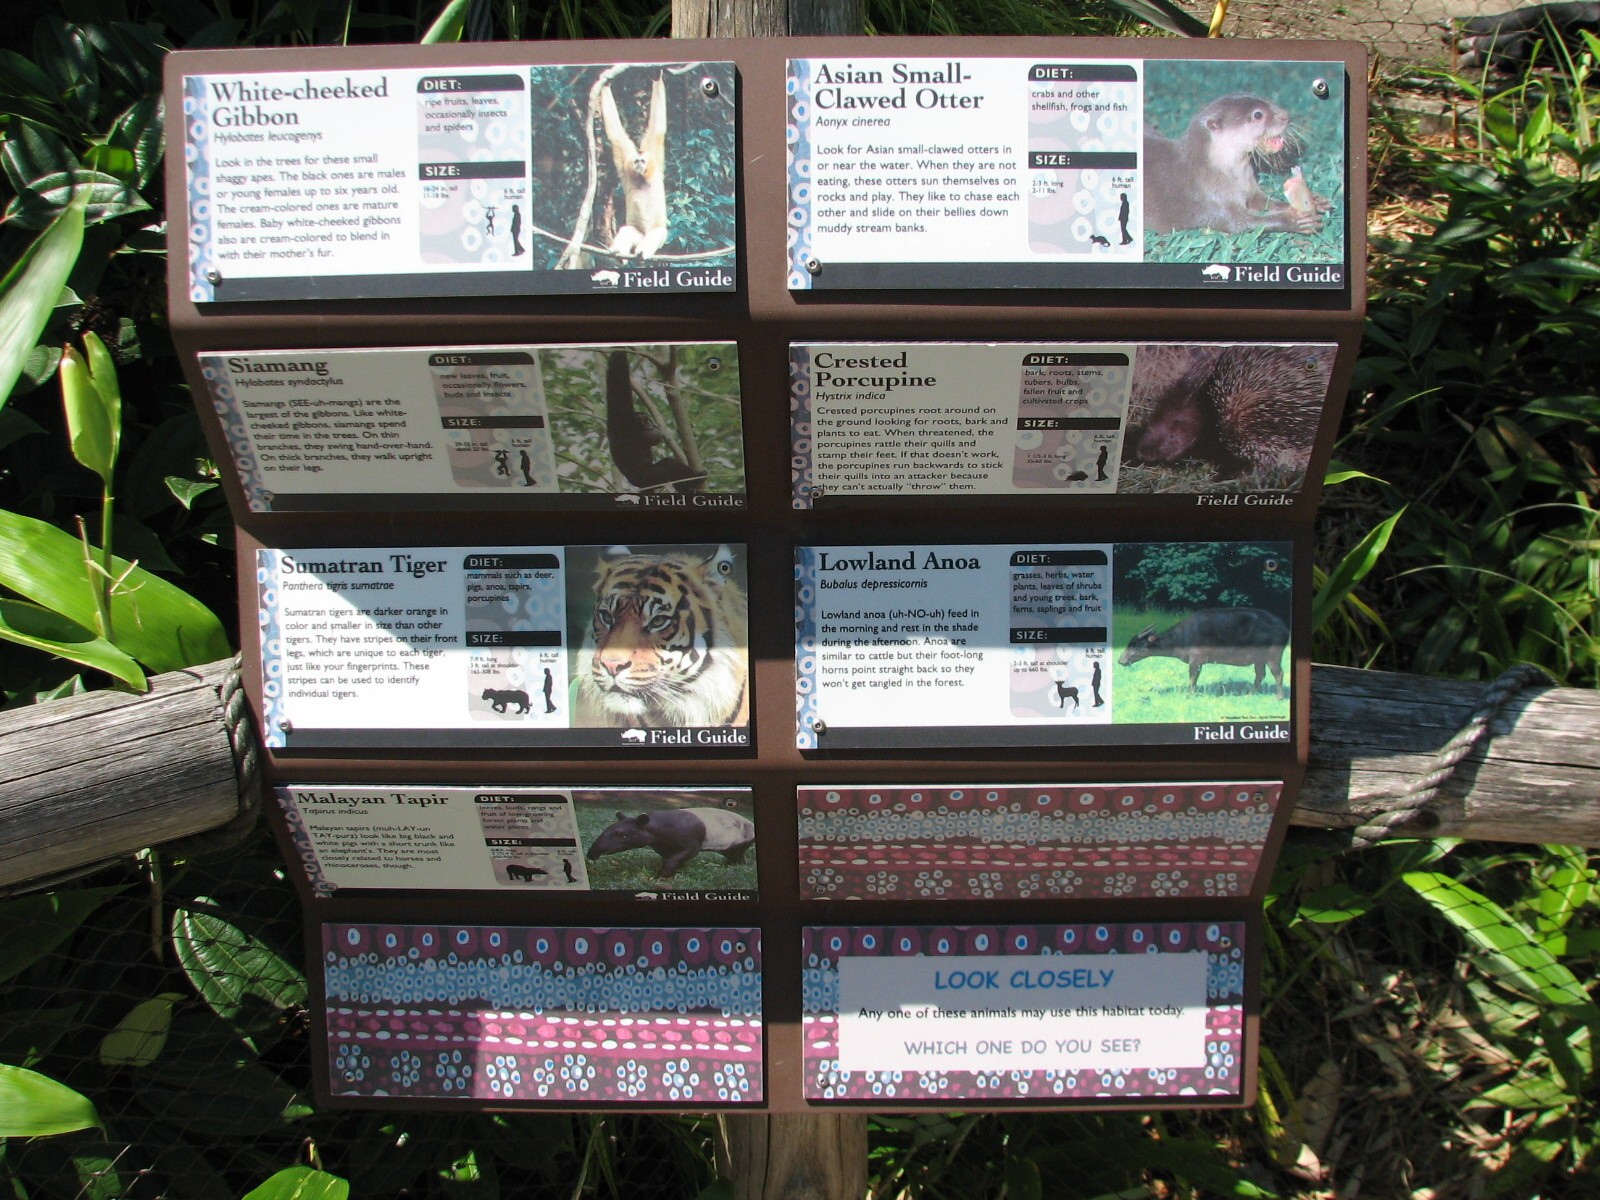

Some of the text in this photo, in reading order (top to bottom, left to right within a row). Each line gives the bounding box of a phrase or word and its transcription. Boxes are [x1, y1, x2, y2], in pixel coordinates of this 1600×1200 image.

[814, 62, 971, 84] Asian Small-
[1035, 68, 1073, 79] DIET:
[210, 77, 388, 101] White-cheeked
[423, 79, 461, 90] DIET:
[815, 87, 984, 109] Clawed Otter
[1031, 89, 1100, 99] crabs and other
[423, 96, 499, 108] ripe fruits, leaves,
[1031, 101, 1128, 113] shellfish, frogs and fish
[211, 106, 299, 127] Gibbon
[424, 109, 508, 121] occasionally insects
[424, 122, 474, 133] and spiders
[815, 116, 891, 129] Aonyx cinerea
[213, 130, 323, 145] Hylobates leucogenys
[816, 144, 1011, 154] Look for Asian small-clawed otters in
[1035, 154, 1070, 164] SIZE:
[424, 165, 460, 176] SIZE:
[1051, 180, 1064, 188] long
[216, 201, 399, 213] The cream-colored ones are mature
[623, 270, 732, 287] Field Guide
[1234, 265, 1340, 282] Field Guide
[228, 357, 329, 375] Siamang
[435, 356, 470, 364] DIET:
[814, 352, 906, 368] Crested
[1030, 356, 1068, 364] DIET:
[1025, 369, 1045, 377] bark,
[235, 378, 284, 387] Hylobates
[815, 370, 936, 391] Porcupine
[815, 391, 885, 401] Hystrix indica
[860, 406, 915, 416] porcupines
[944, 406, 980, 415] around
[644, 493, 743, 506] Field Guide
[1195, 494, 1293, 505] Field Guide
[281, 554, 447, 575] Sumatran Tiger
[469, 557, 502, 568] DIET:
[818, 551, 981, 571] Lowland Anoa
[1016, 554, 1050, 564] DIET:
[466, 572, 502, 580] mammals
[504, 571, 522, 579] such
[534, 571, 555, 579] deer,
[1012, 570, 1094, 581] grasses, herbs, water
[282, 580, 323, 590] Panthera
[326, 580, 348, 592] tigris
[467, 583, 484, 592] pigs,
[508, 582, 532, 593] tapirs,
[819, 578, 928, 590] Bubalus depressicornis
[1012, 581, 1102, 592] plants, leaves of shrubs
[467, 593, 509, 604] porcupines
[284, 606, 448, 618] Sumatran tigers are darker orange in
[820, 609, 861, 619] Lowland
[888, 608, 946, 620] (uh-NO-uh)
[947, 608, 968, 617] feed
[970, 609, 979, 617] in
[471, 634, 502, 643] SIZE:
[1015, 630, 1047, 639] SIZE:
[650, 728, 746, 745] Field Guide
[1193, 724, 1289, 740] Field Guide
[297, 792, 448, 807] Malayan Tapir
[661, 892, 750, 900] Field Guide
[934, 968, 1114, 989] LOOK CLOSELY
[858, 1004, 1185, 1021] Any one of these animals may use this habitat today.
[903, 1038, 1141, 1055] WHICH ONE DO YOU SEE?
